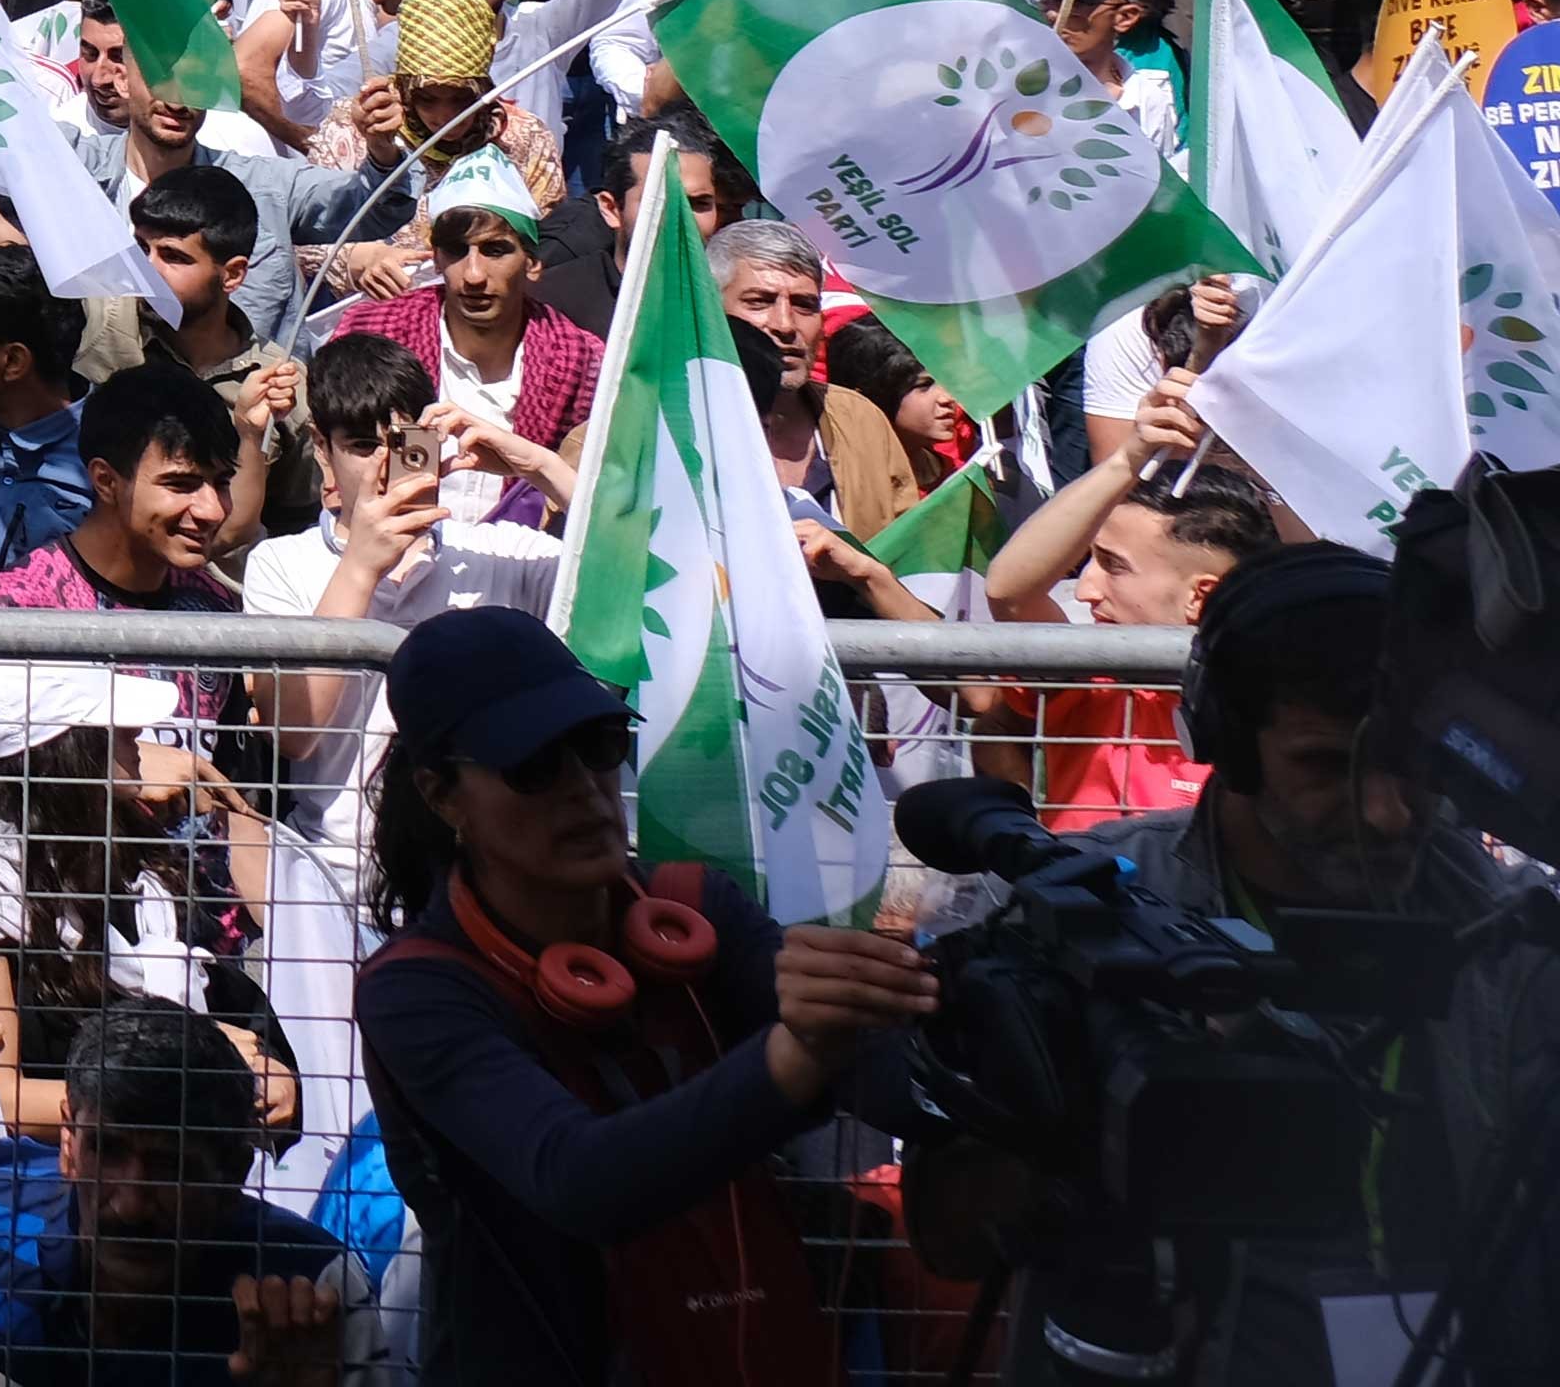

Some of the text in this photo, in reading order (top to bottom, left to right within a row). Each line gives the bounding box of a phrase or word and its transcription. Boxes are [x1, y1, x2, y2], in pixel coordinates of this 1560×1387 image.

[1408, 14, 1458, 46] BE
[805, 186, 878, 251] PARTİ
[824, 153, 923, 255] YEŞİL SOL
[697, 1287, 768, 1311] Columbia
